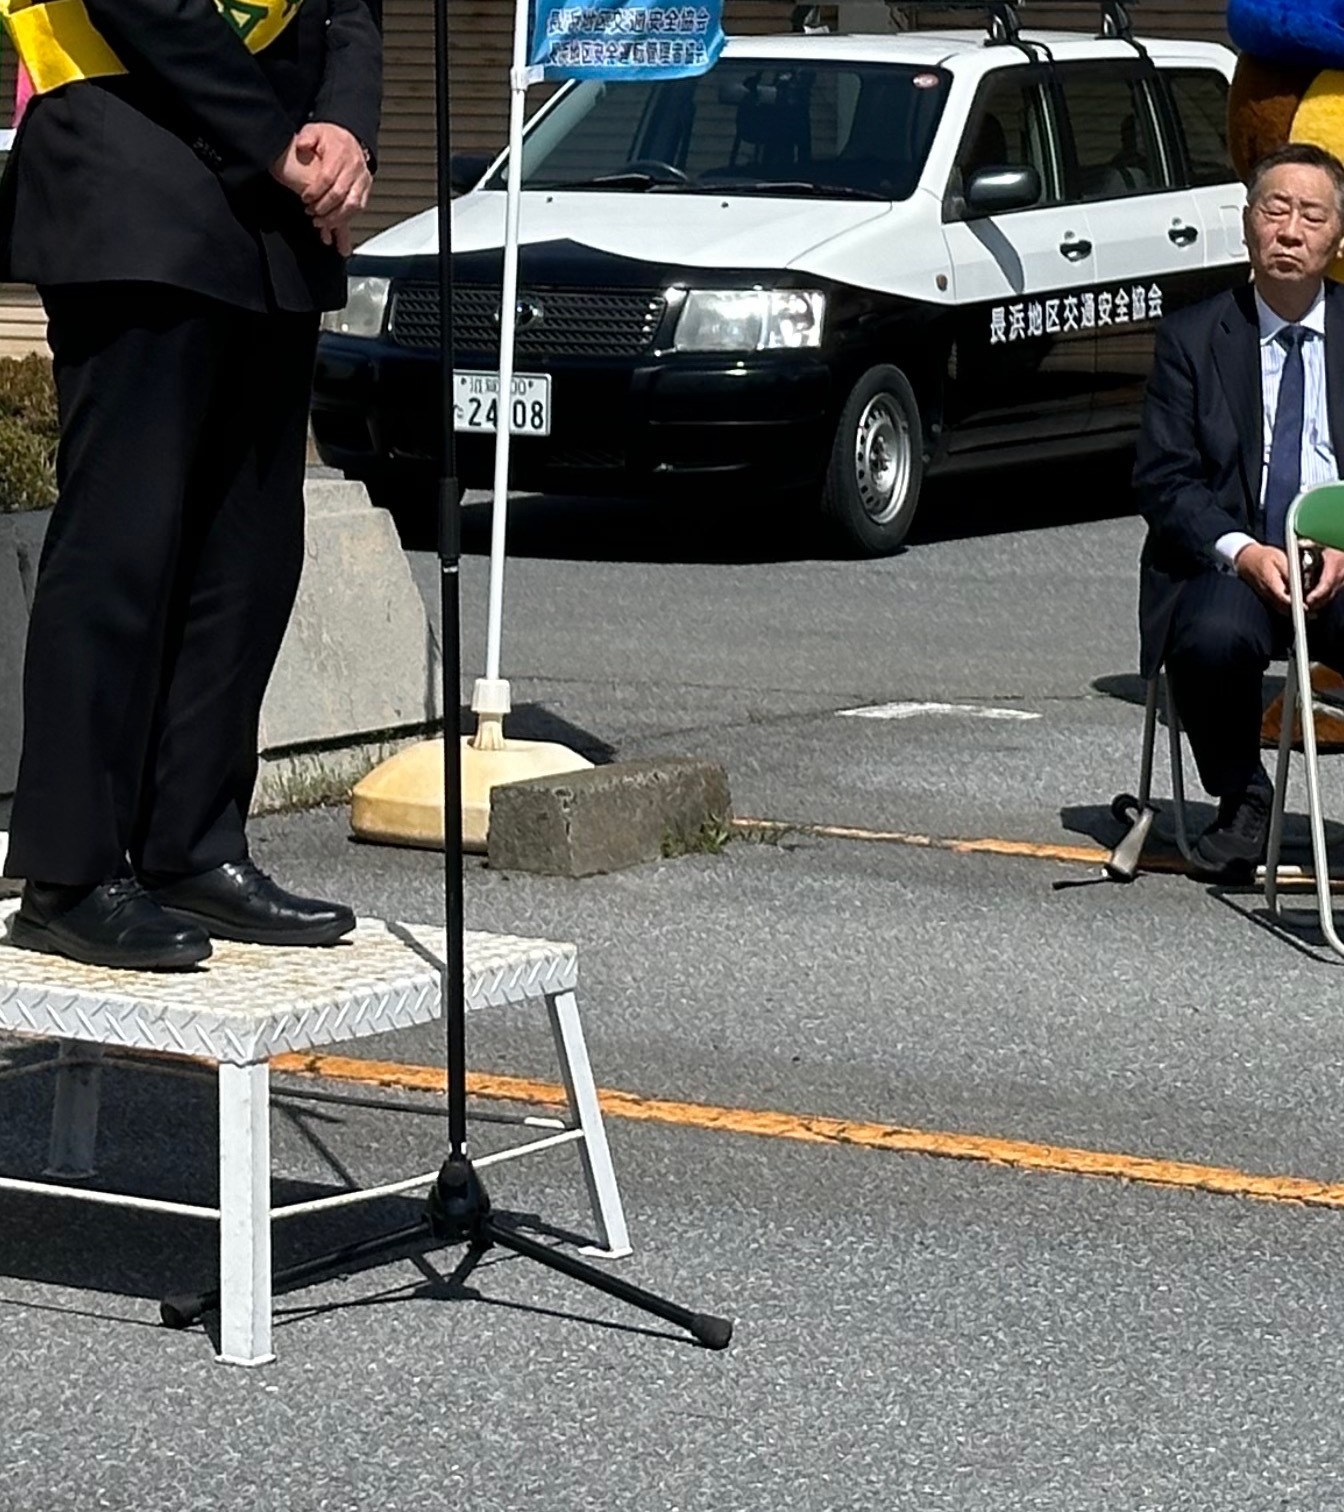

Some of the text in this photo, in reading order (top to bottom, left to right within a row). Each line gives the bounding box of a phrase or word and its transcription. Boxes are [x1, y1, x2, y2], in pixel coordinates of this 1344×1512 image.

[989, 283, 1164, 345] 長浜地区交通安全協会
